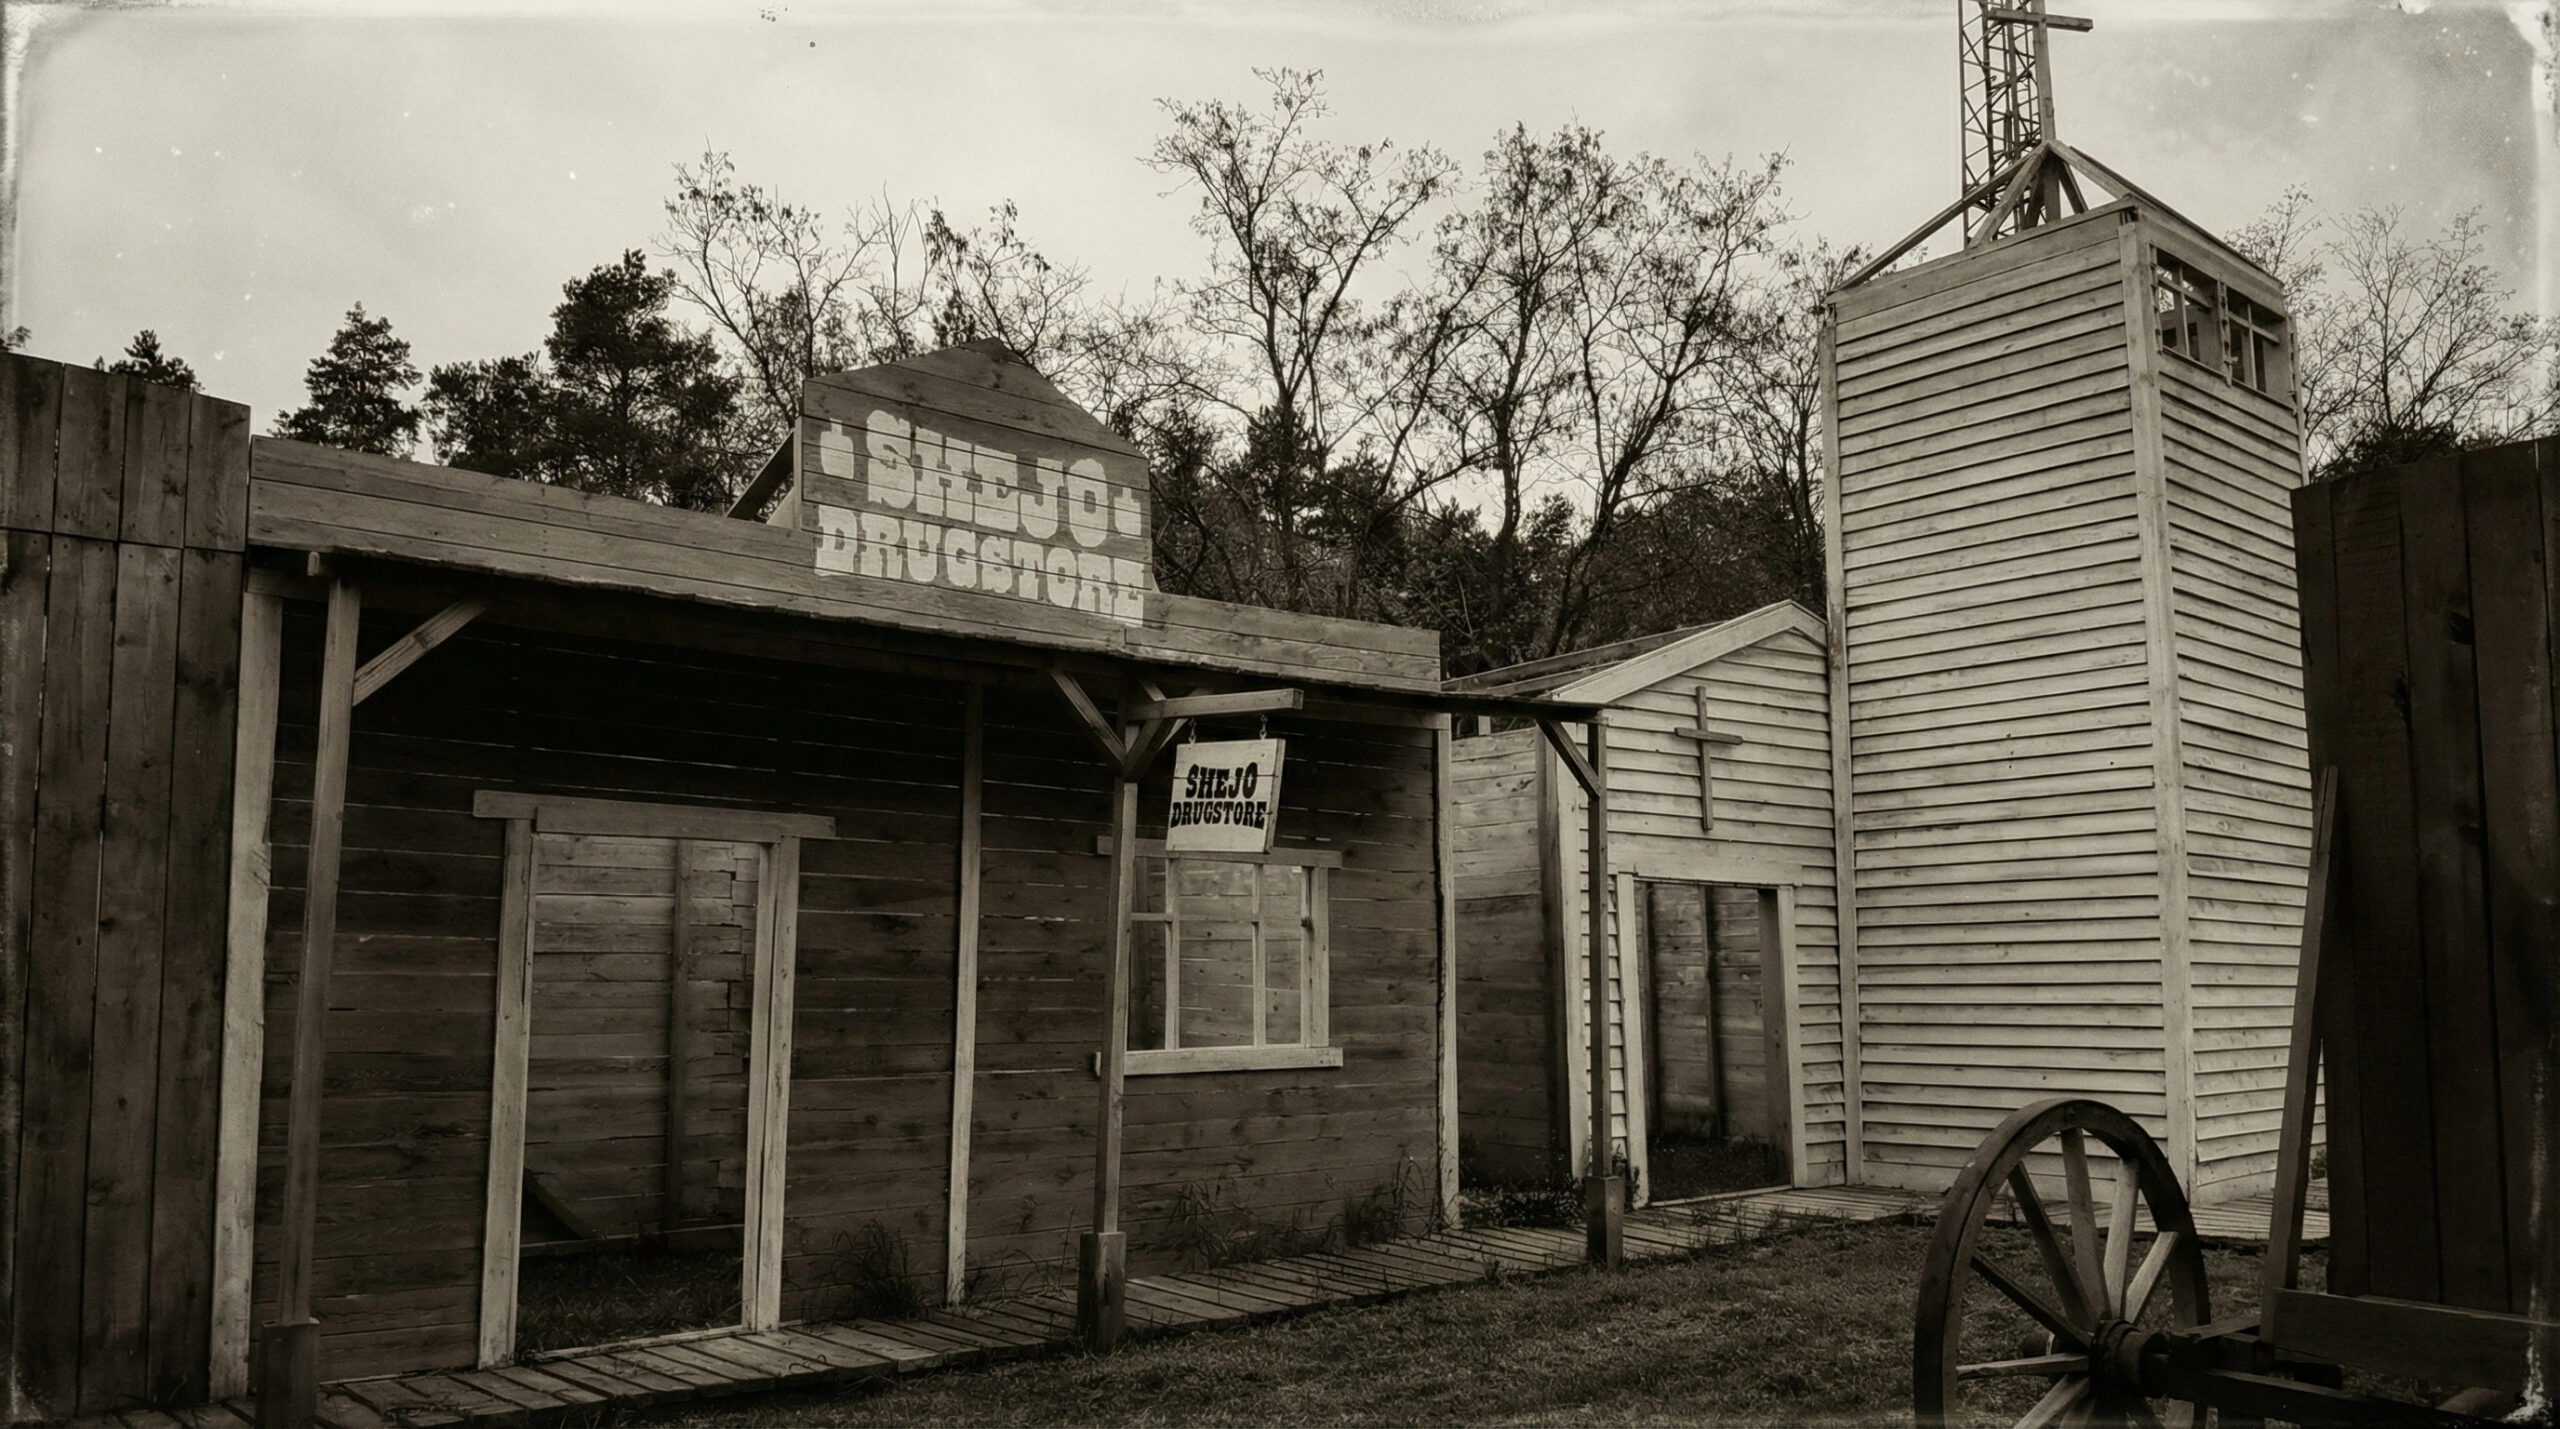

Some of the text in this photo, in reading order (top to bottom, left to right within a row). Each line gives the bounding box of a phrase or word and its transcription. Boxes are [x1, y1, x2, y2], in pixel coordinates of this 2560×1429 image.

[866, 410, 1108, 547] SHEJO
[814, 504, 1144, 627] DRUGSTORE
[1170, 801, 1267, 830] DRUGSTORE
[1186, 762, 1258, 798] SHEJO
